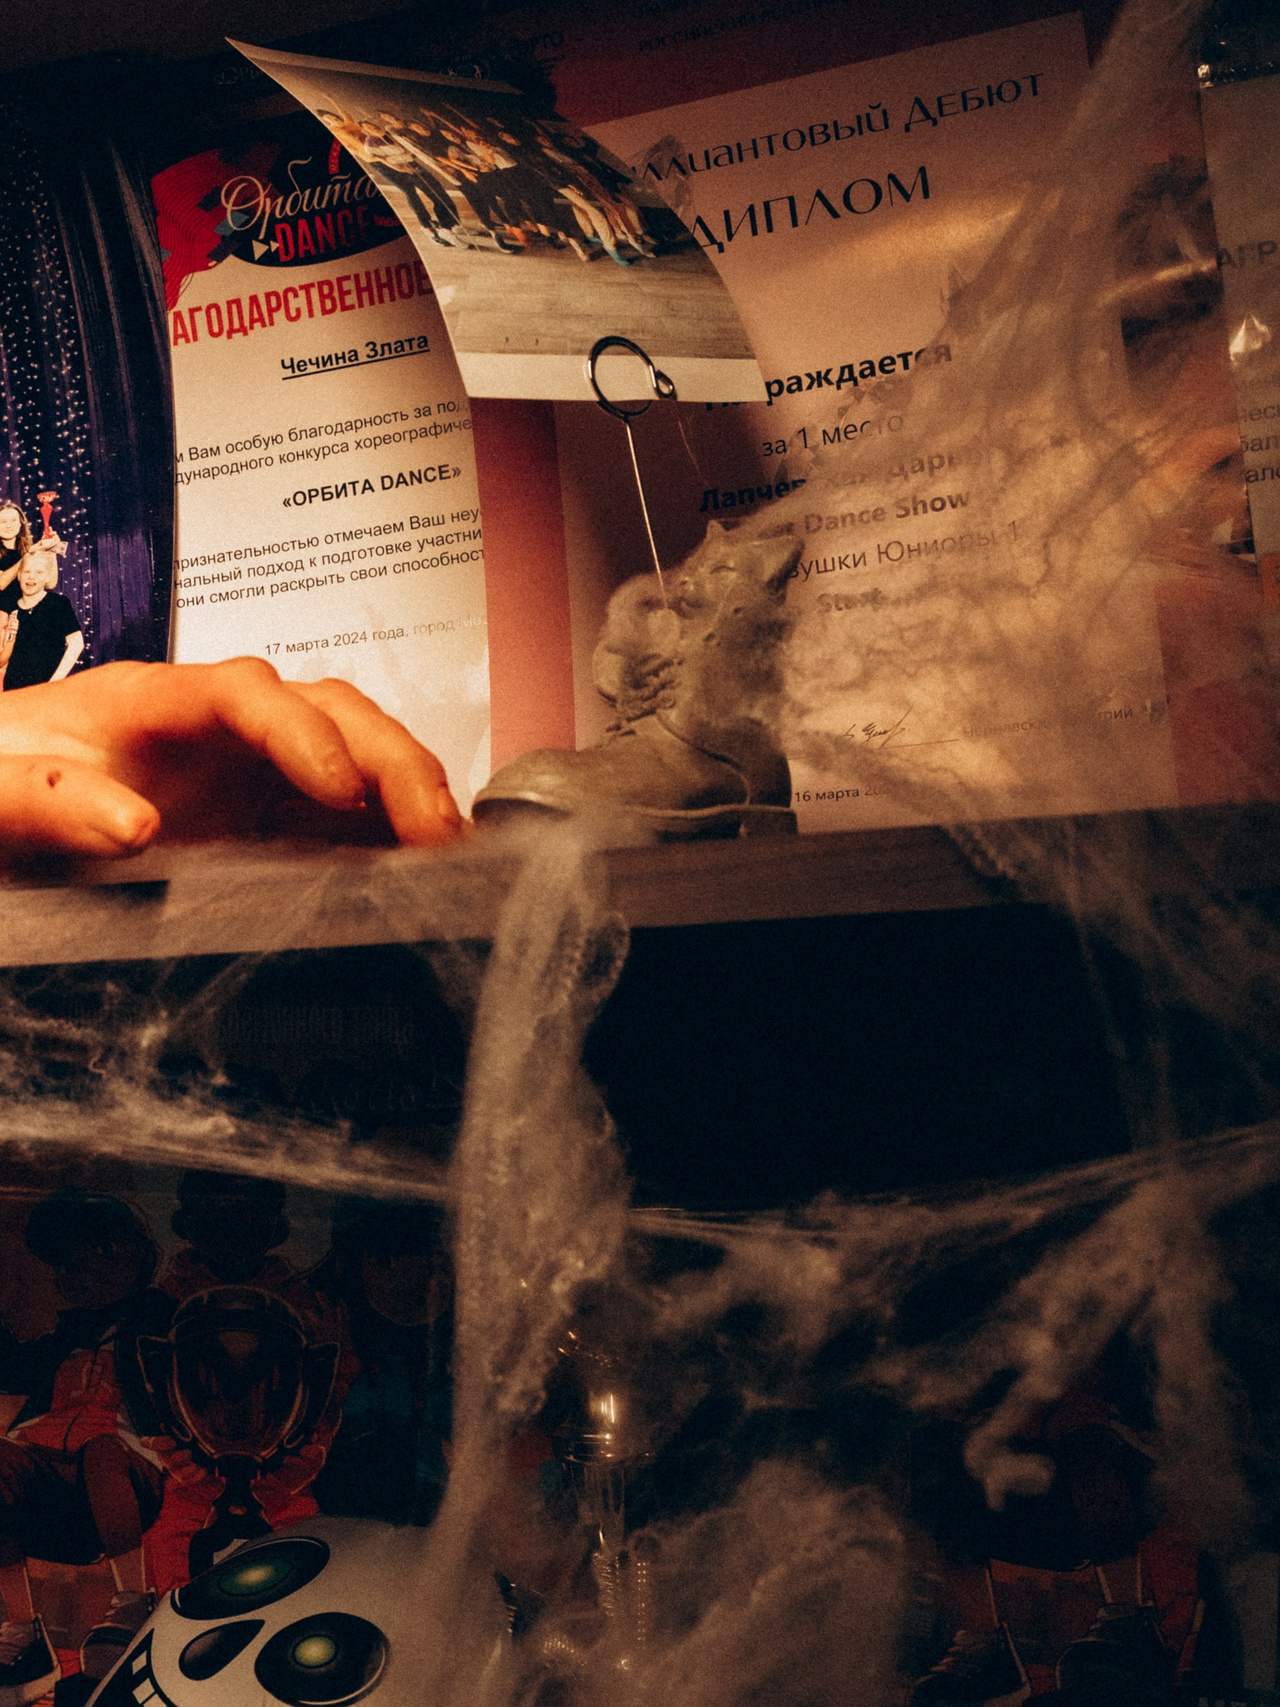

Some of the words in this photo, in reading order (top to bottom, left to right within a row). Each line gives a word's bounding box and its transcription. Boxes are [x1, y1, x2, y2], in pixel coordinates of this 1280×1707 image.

[274, 204, 370, 263] DANCE
[280, 344, 360, 376] Чечина
[364, 334, 430, 360] Злата
[188, 445, 221, 462] Вам
[224, 430, 284, 454] особую
[288, 411, 410, 442] благодарность
[413, 405, 432, 419] за
[278, 441, 350, 467] конкурса
[354, 418, 472, 450] хореографиче
[762, 439, 787, 457] за
[797, 426, 809, 449] 1
[822, 414, 904, 446] место
[282, 478, 375, 508] «ОРБИТА
[380, 463, 462, 492] DANCE»
[324, 521, 404, 546] отмечаем
[409, 514, 446, 530] Ваш
[804, 504, 887, 534] Dance
[895, 490, 970, 519] Show
[247, 560, 305, 584] подход
[308, 558, 317, 569] к
[321, 540, 413, 567] подготовке
[417, 528, 482, 553] участни
[176, 594, 205, 609] они
[209, 584, 266, 605] смогли
[270, 572, 346, 597] раскрыть
[350, 565, 389, 582] свои
[265, 643, 281, 656] 17
[285, 637, 330, 657] марта
[333, 631, 368, 647] 2024
[794, 790, 811, 803] 16
[815, 788, 860, 804] марта
